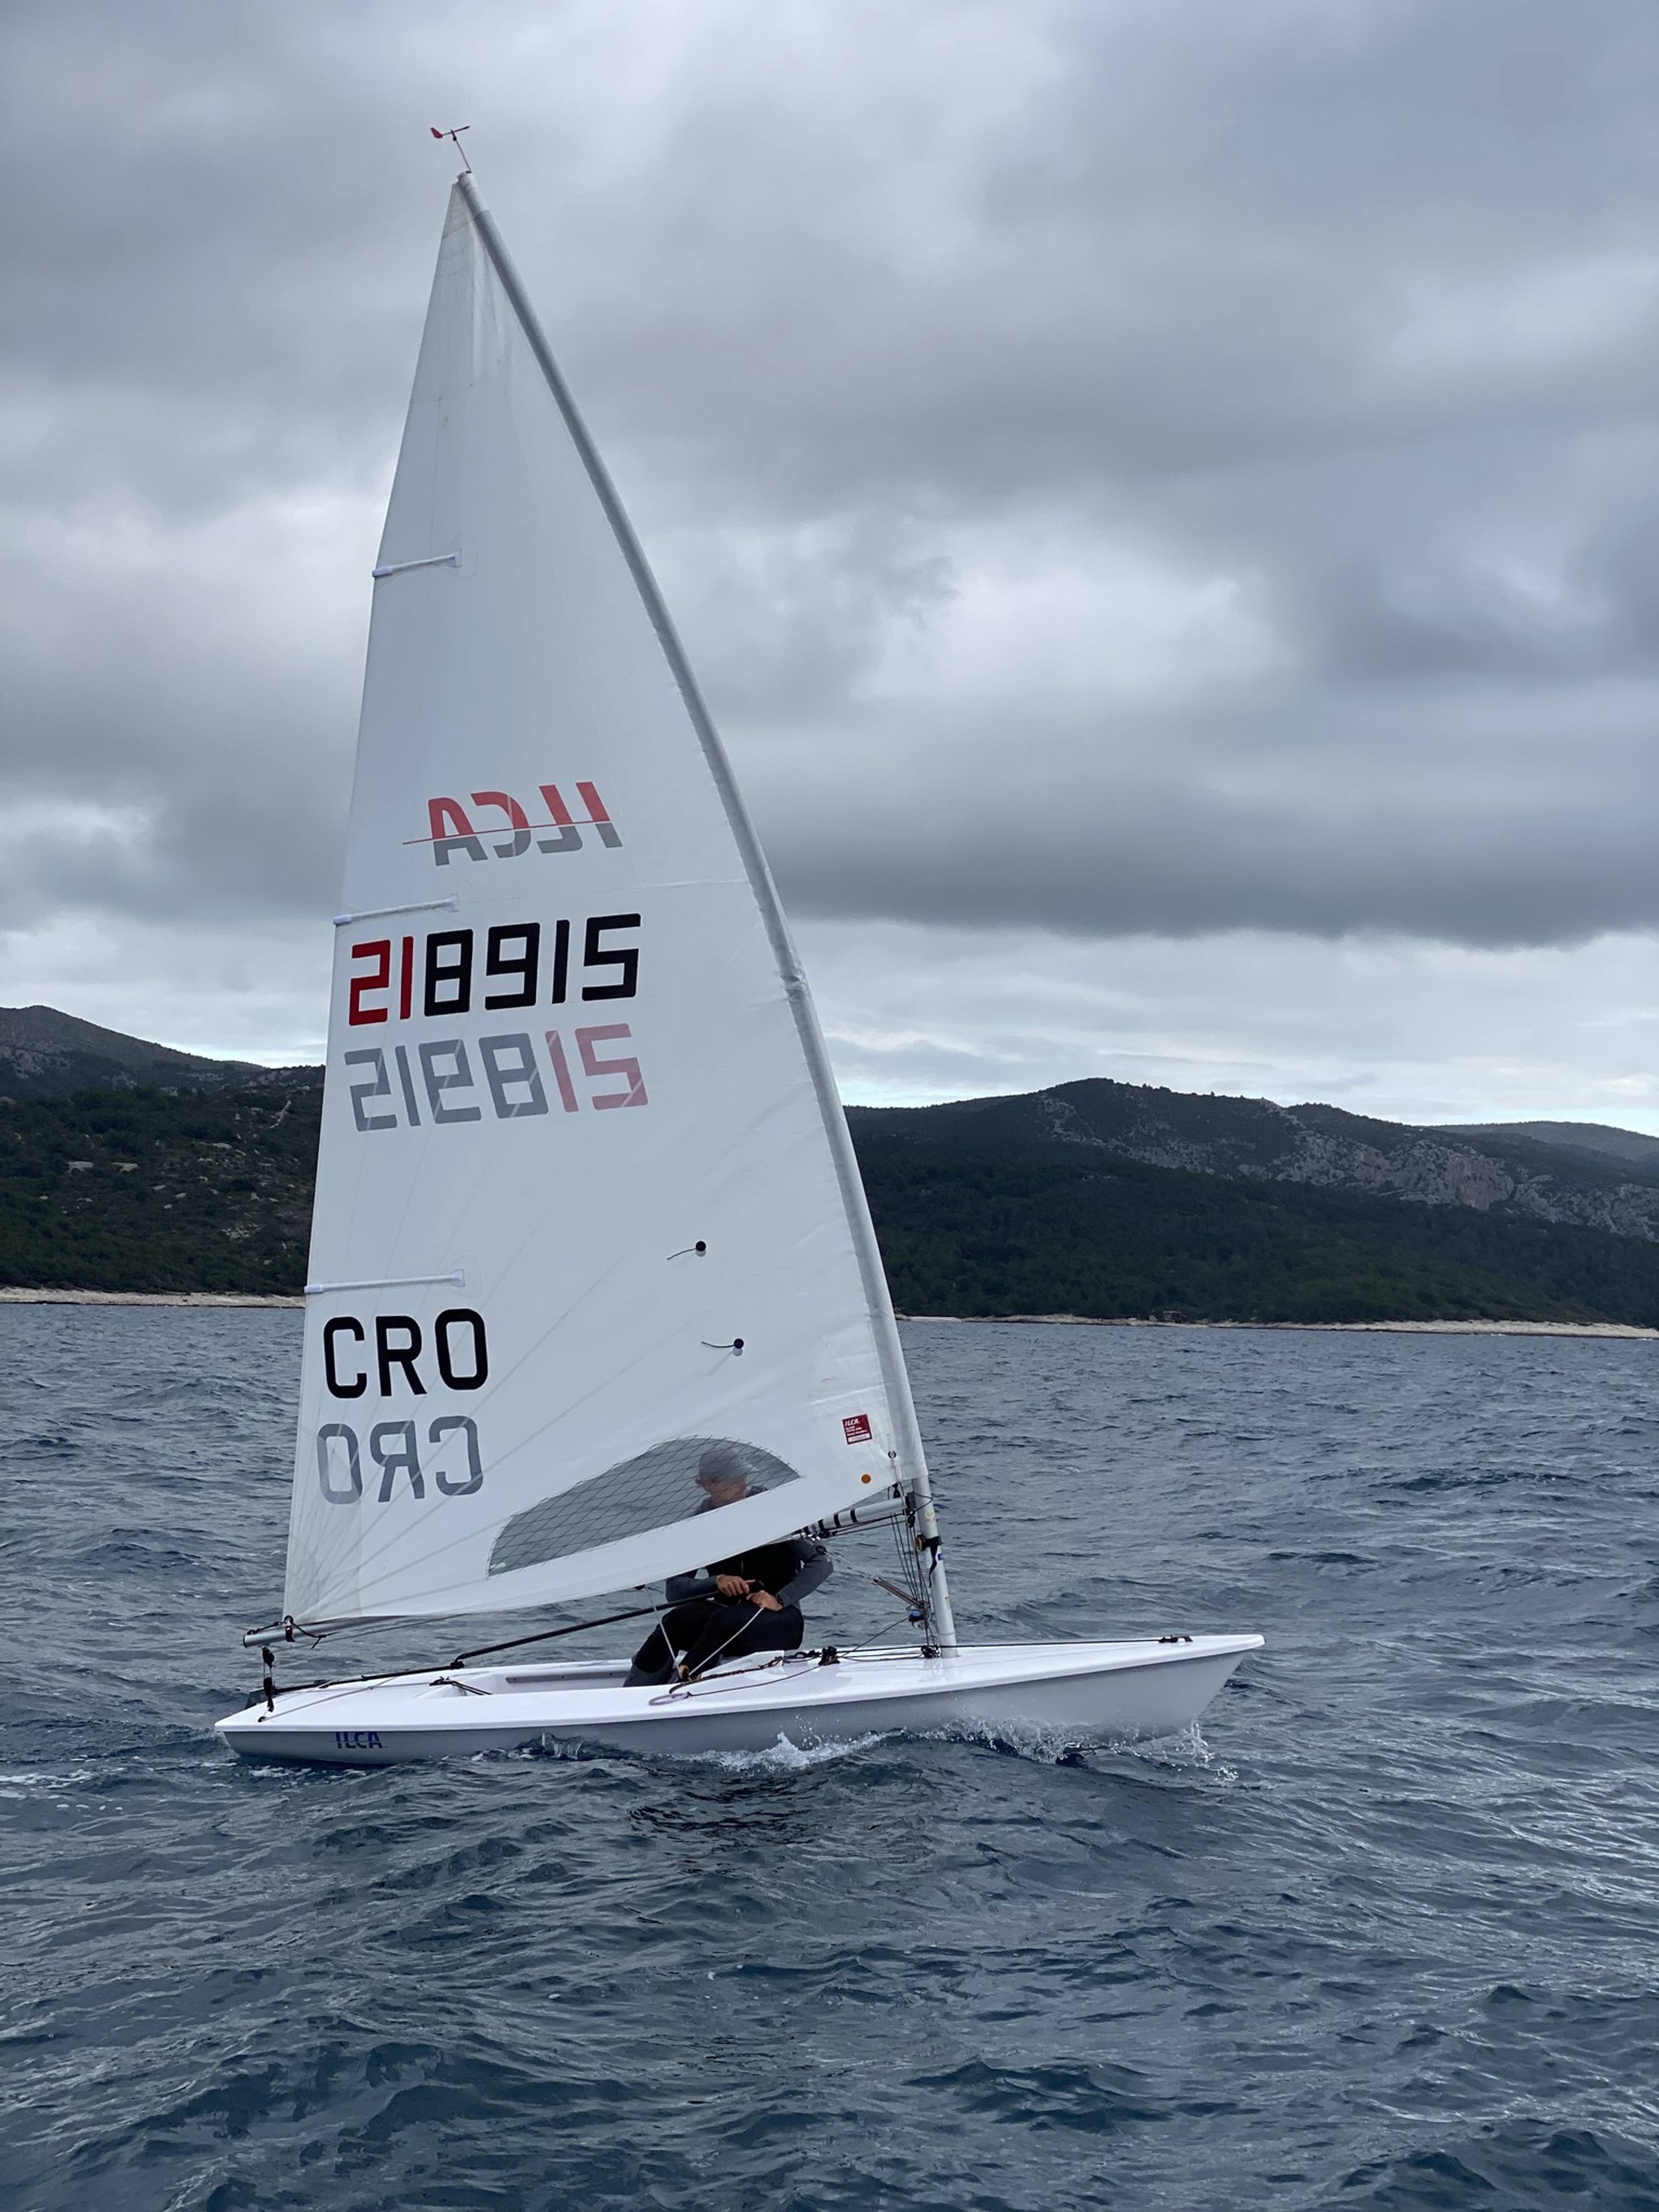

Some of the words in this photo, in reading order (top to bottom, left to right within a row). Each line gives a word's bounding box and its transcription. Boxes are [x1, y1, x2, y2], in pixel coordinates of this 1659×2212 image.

[349, 913, 642, 1026] 218915
[323, 1308, 488, 1399] CRO
[844, 1418, 858, 1426] ILCA
[334, 1731, 382, 1749] ILCA
